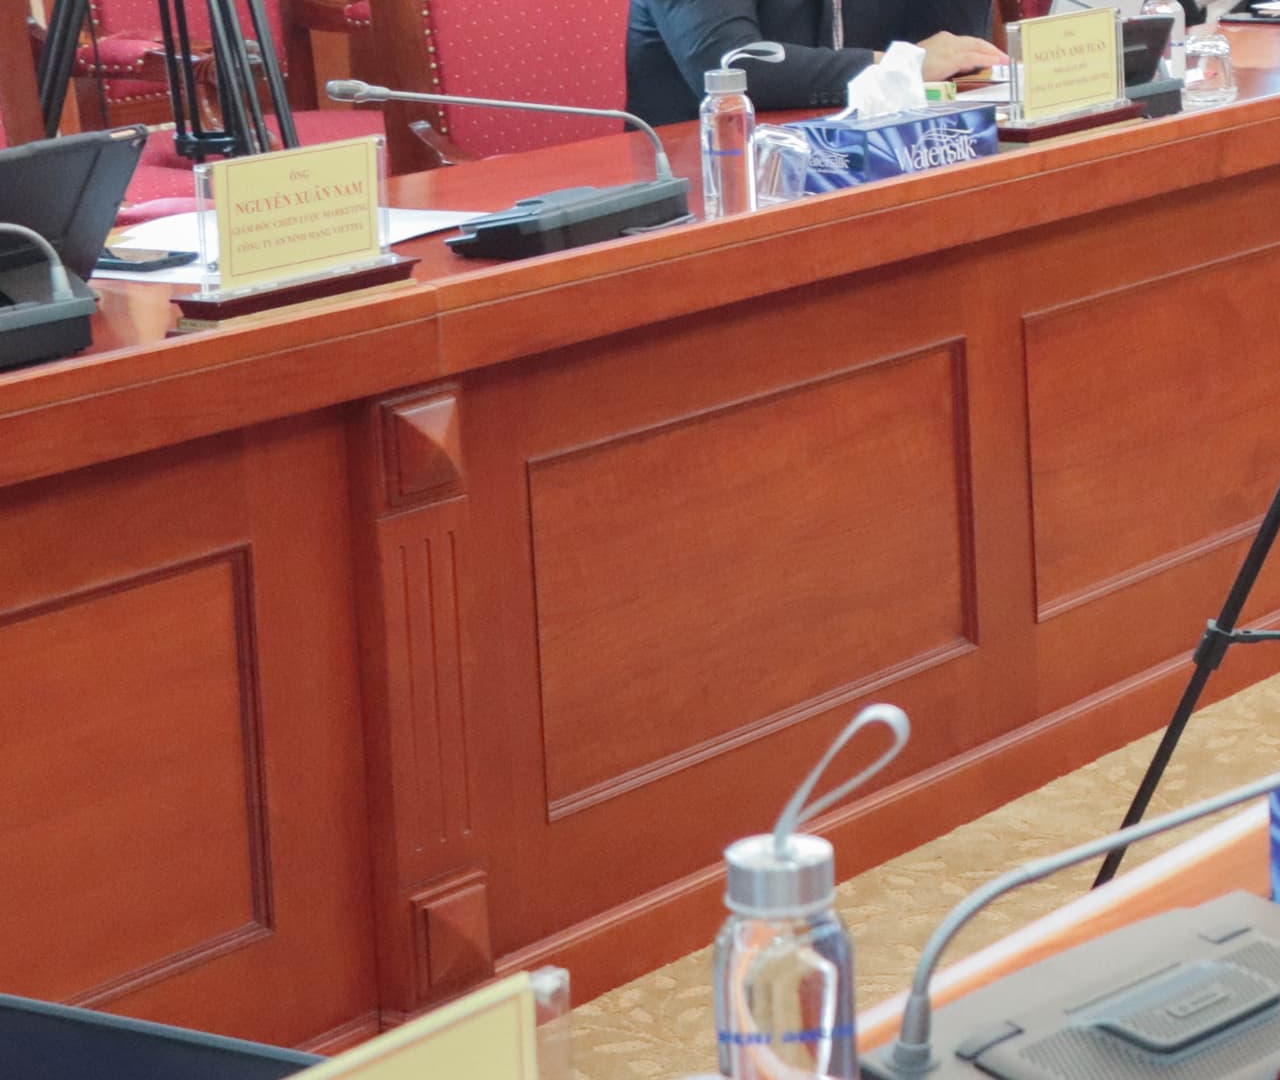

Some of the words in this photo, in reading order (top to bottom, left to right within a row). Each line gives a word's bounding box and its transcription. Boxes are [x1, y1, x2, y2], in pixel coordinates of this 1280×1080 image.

[807, 151, 850, 170] atersilk
[895, 130, 979, 172] Watersilk
[235, 192, 292, 217] NGUYỄN
[294, 184, 331, 207] XUÂN
[333, 181, 363, 197] NAM
